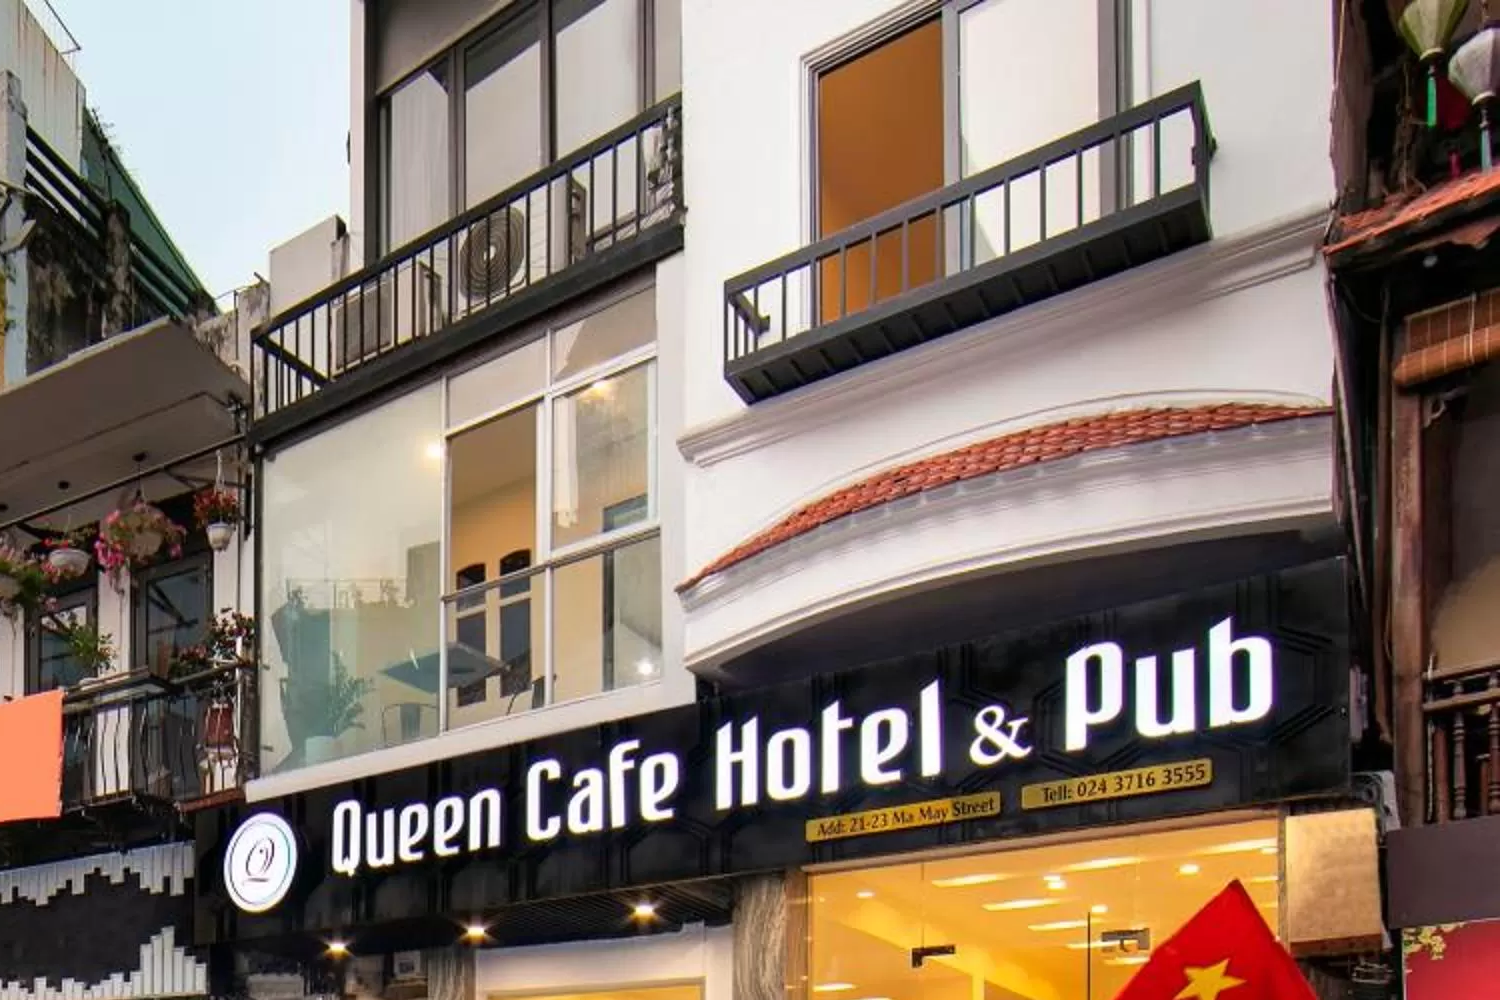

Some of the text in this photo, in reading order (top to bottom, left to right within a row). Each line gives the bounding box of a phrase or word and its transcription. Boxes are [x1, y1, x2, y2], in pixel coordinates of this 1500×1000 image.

[332, 616, 1273, 878] Queen Cafe Hotel & Pub
[1043, 762, 1206, 804] Tell: 024 3716 3555
[817, 796, 995, 838] Add: 21-23 Ma May Street
